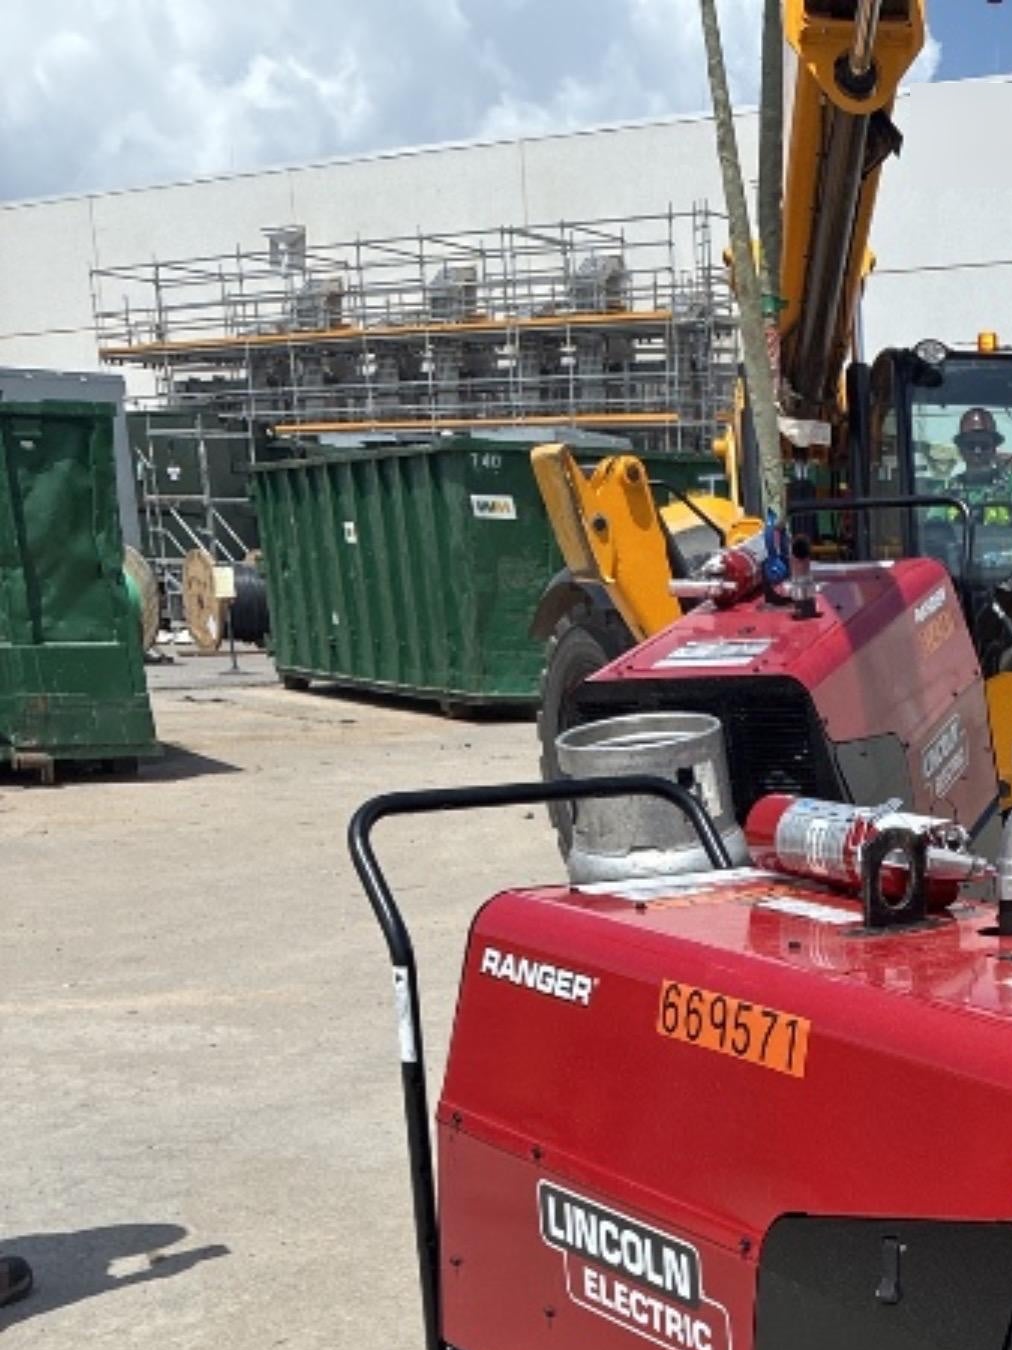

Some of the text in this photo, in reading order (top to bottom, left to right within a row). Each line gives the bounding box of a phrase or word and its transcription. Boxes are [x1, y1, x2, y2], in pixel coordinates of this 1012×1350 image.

[479, 946, 593, 1006] RANGER
[661, 983, 799, 1071] 669571
[546, 1195, 692, 1300] LINCOLN
